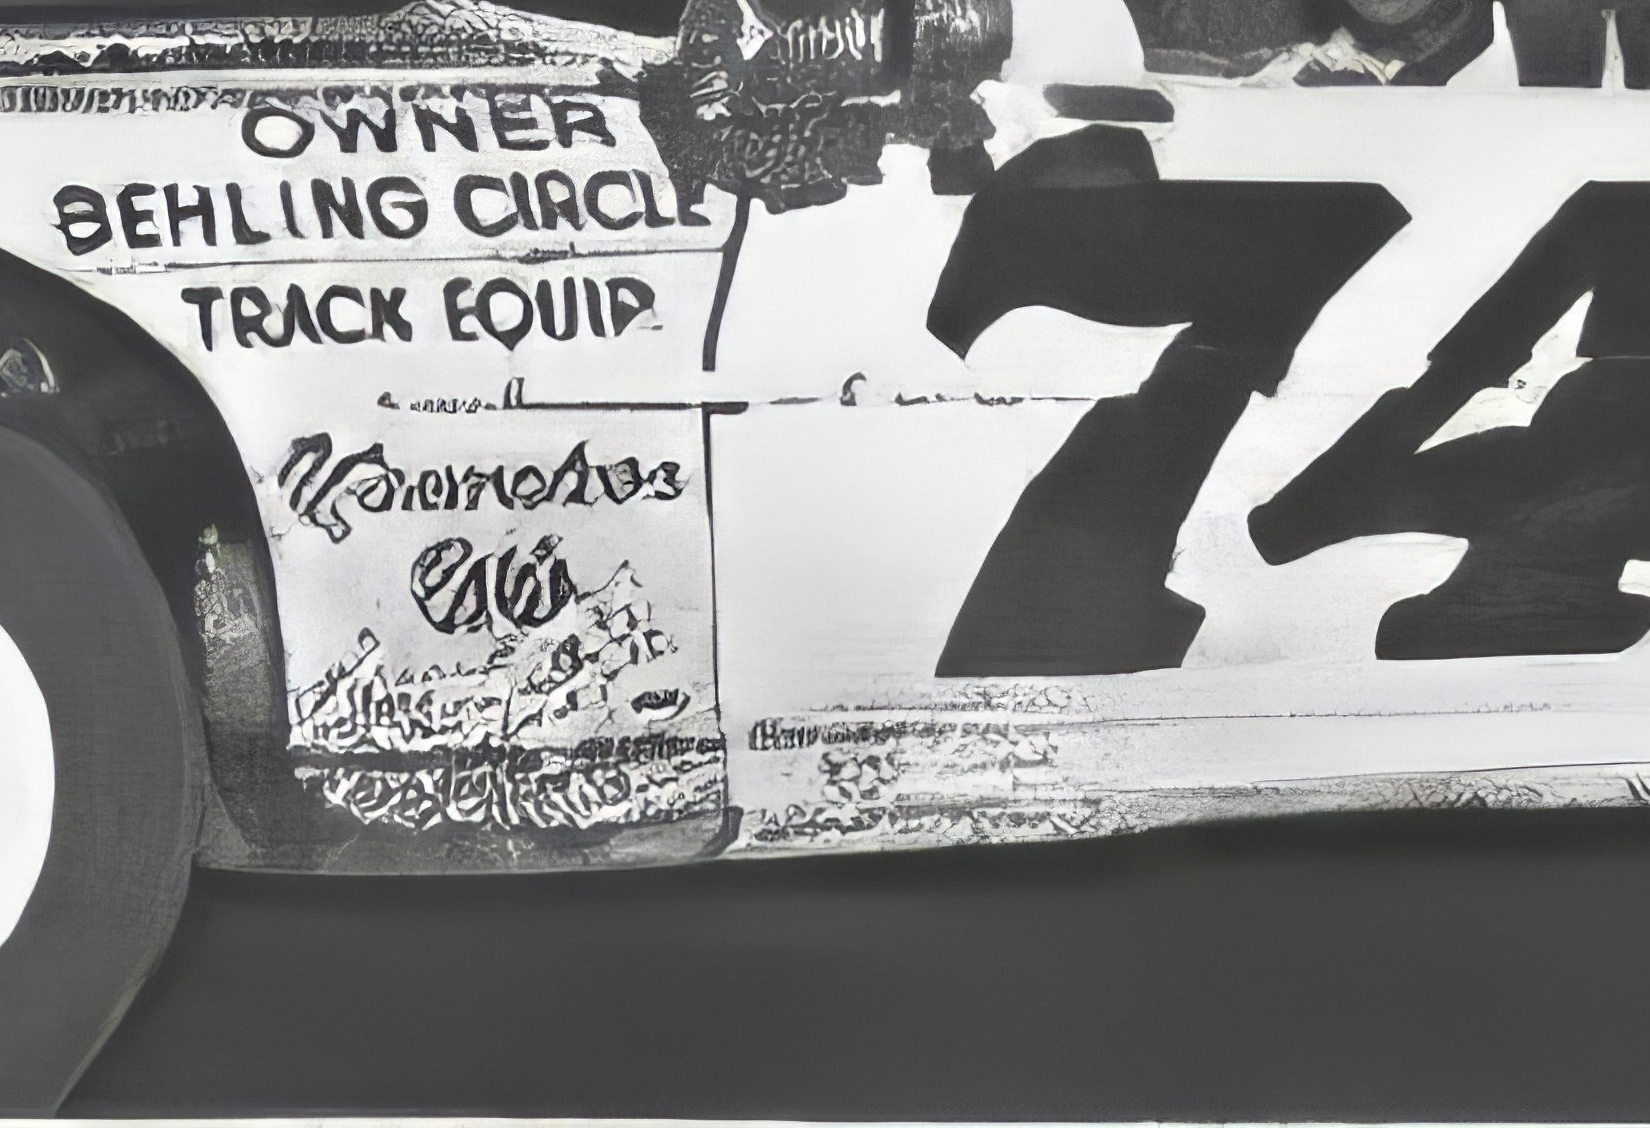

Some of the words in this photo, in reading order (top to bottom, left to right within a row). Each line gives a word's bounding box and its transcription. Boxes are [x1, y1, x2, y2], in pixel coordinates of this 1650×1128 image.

[241, 93, 617, 158] OWNER
[50, 175, 430, 256] BEHLING
[453, 169, 712, 238] CIRCLE
[180, 283, 413, 352] TRACK
